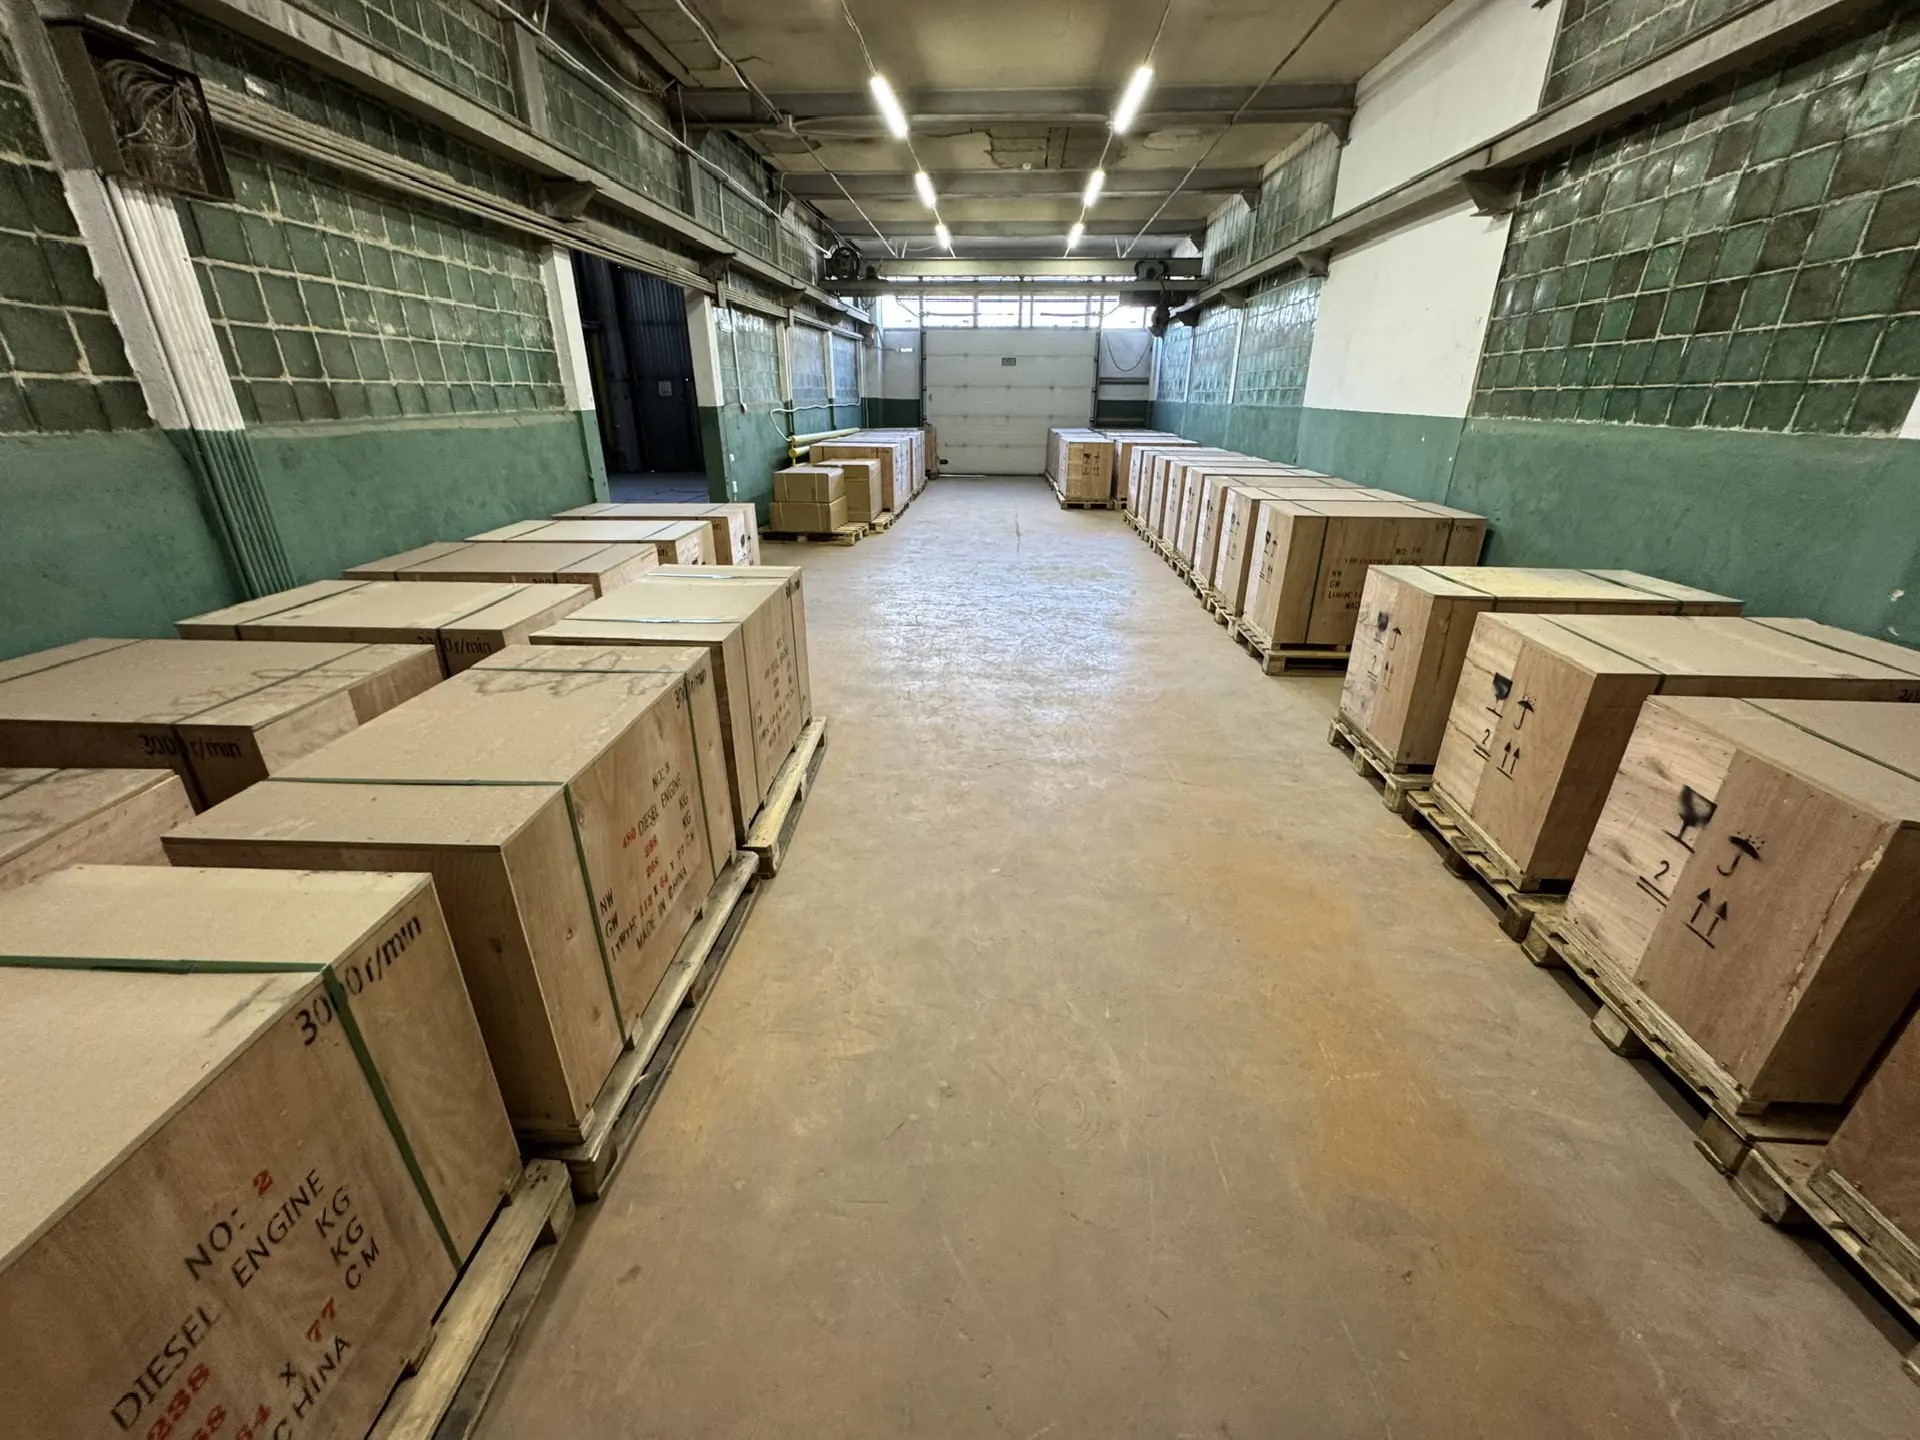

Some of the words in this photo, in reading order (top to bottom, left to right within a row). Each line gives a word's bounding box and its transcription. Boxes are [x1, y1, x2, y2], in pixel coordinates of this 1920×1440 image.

[1482, 728, 1491, 746] 2
[1653, 859, 1670, 880] 2
[599, 887, 614, 916] NW
[605, 911, 619, 939] GW
[183, 1207, 246, 1282] NO:
[252, 1168, 274, 1197] 2
[315, 1185, 351, 1240] KG
[330, 1215, 364, 1267] KG
[109, 1304, 222, 1432] DIESEL
[231, 1168, 324, 1289] ENGINE
